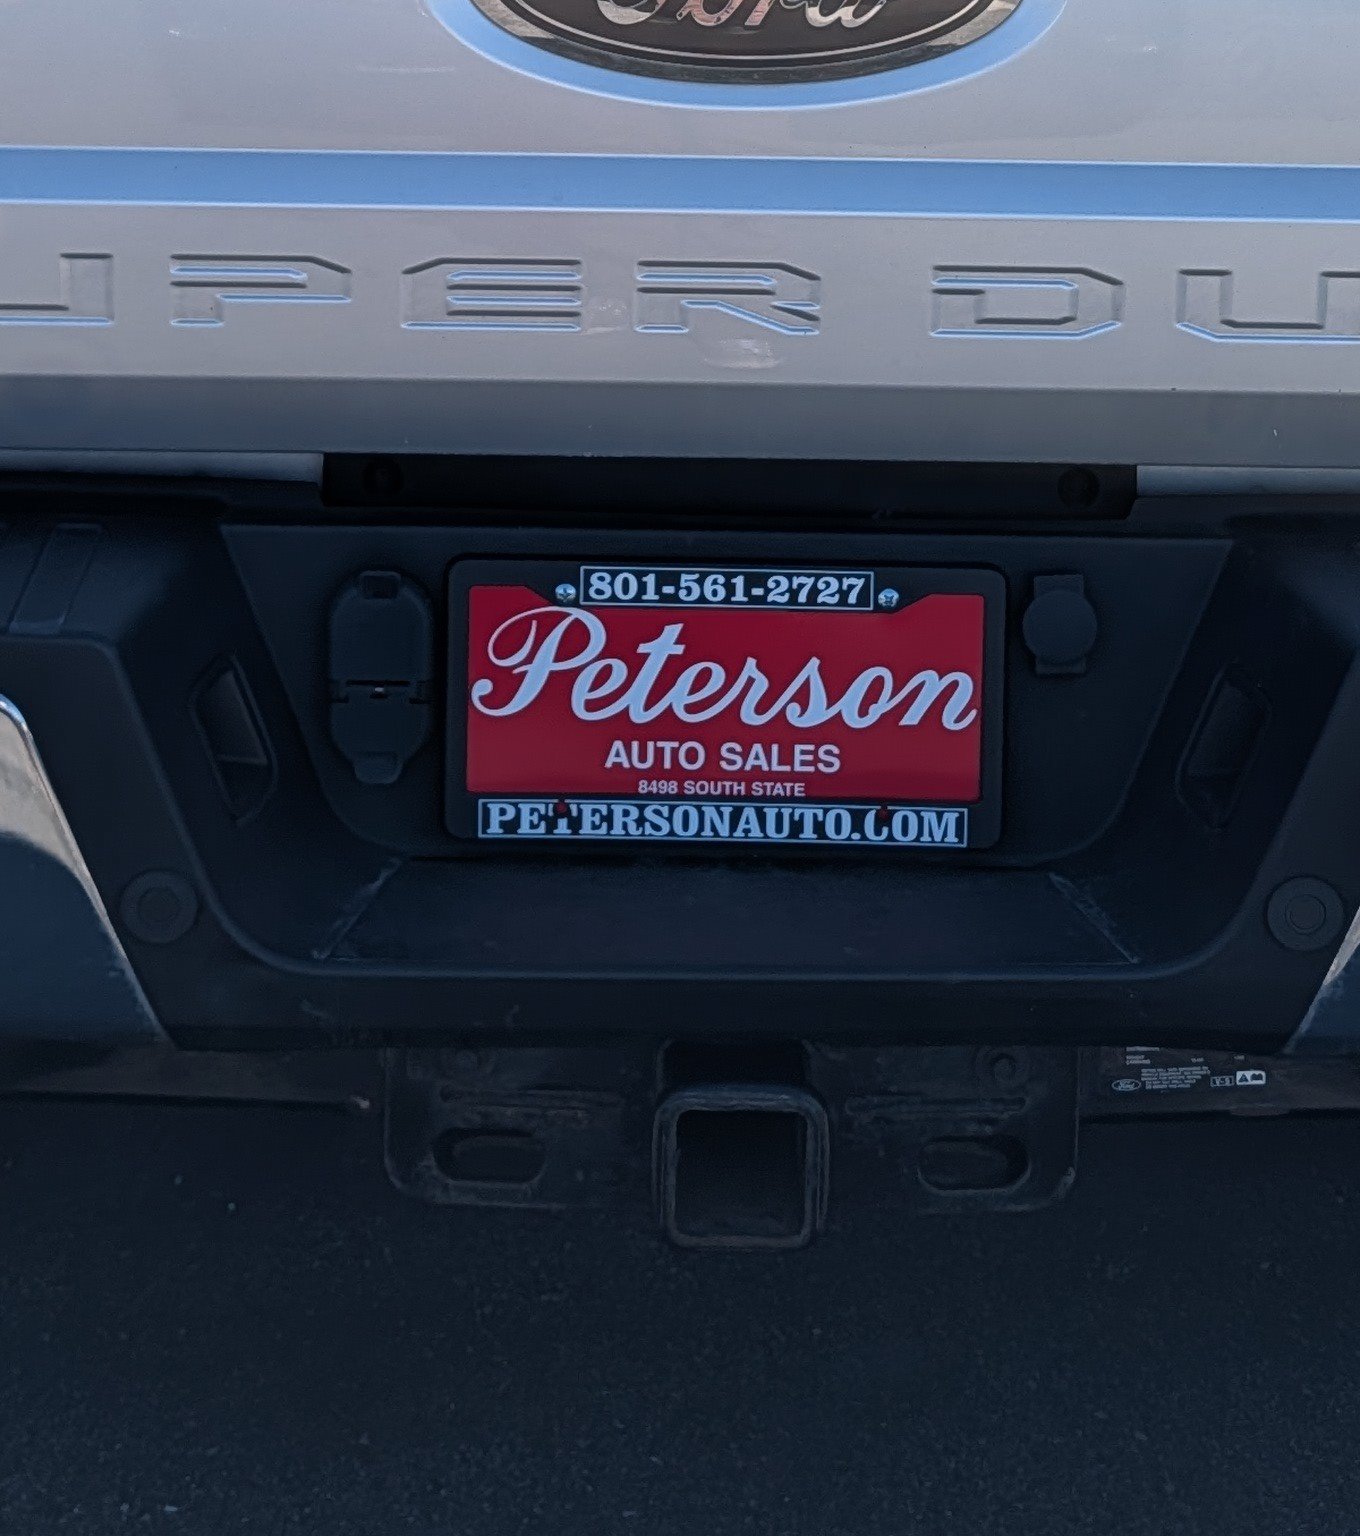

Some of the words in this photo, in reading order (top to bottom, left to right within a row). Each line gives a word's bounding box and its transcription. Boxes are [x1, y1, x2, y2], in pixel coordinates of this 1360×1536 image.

[589, 572, 866, 606] 801-561-2727
[471, 606, 978, 731] Peterson
[604, 741, 706, 770] AUTO
[719, 744, 841, 773] SALES
[638, 781, 678, 795] 8498
[683, 781, 745, 796] SOUTH
[751, 782, 806, 797] STATE
[485, 801, 961, 844] PETERSONAUTO.COM
